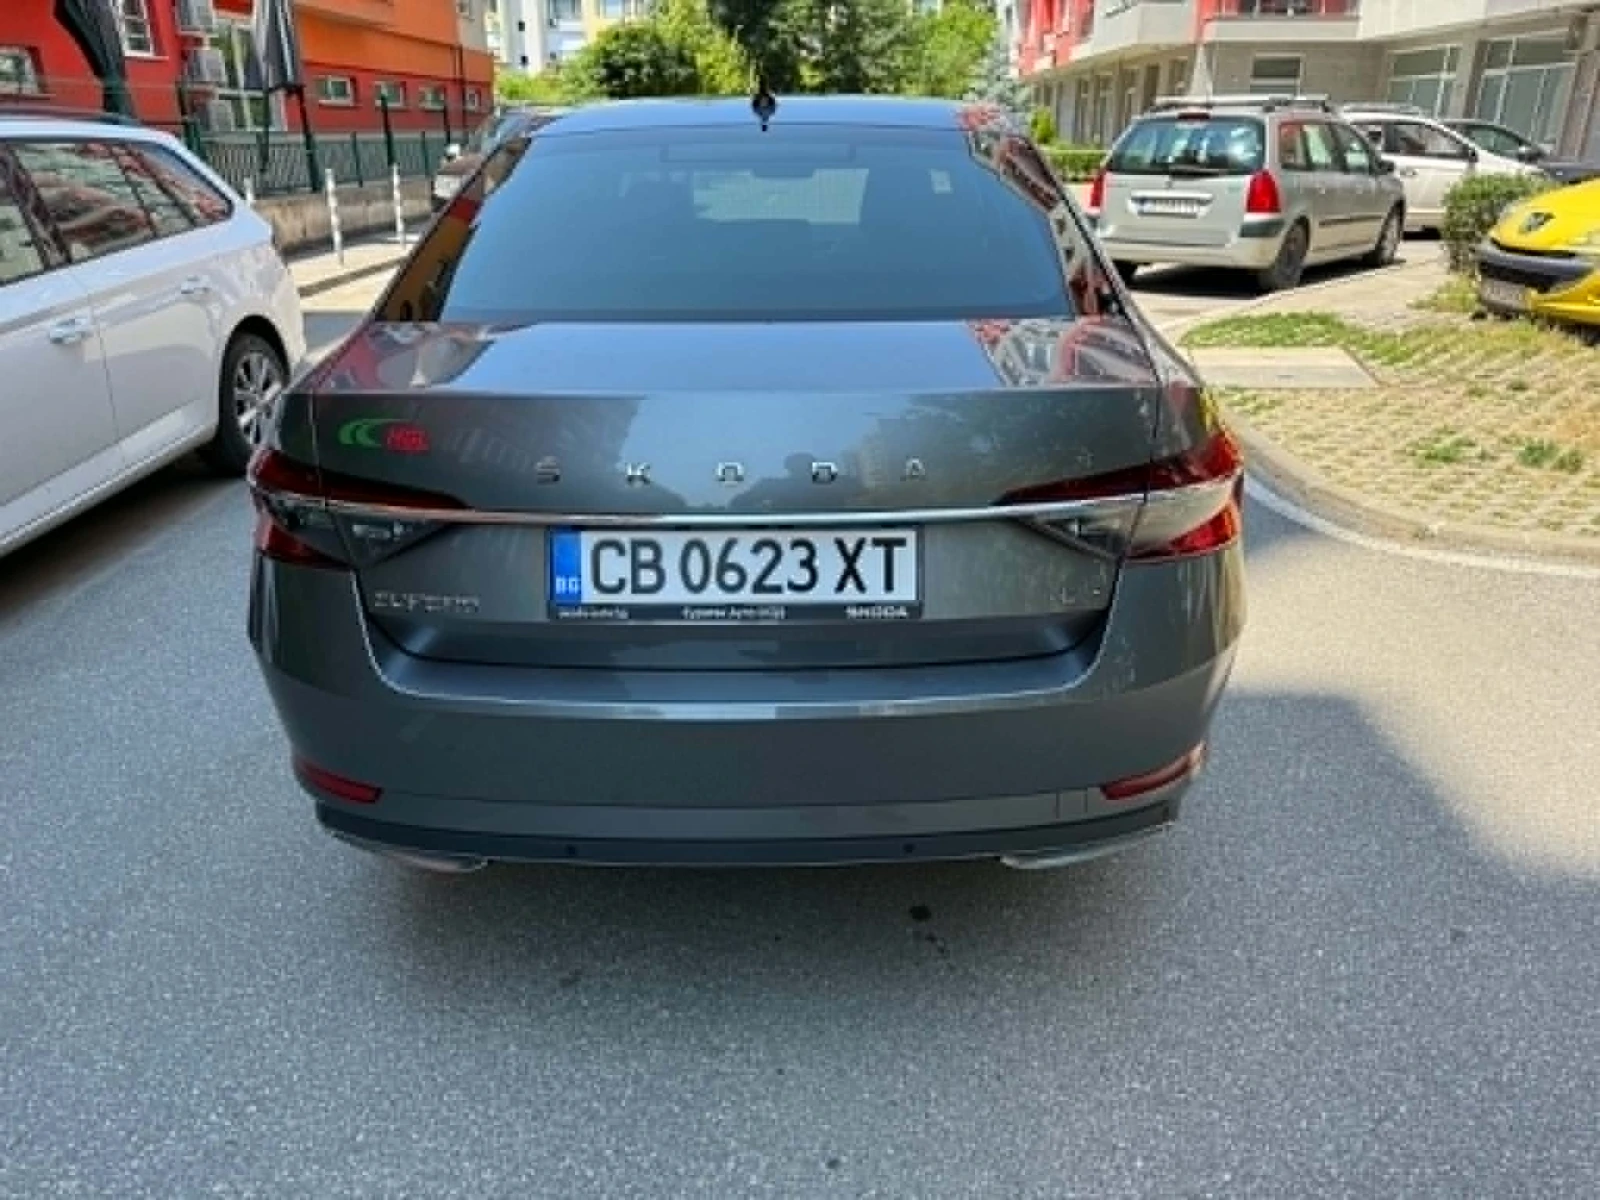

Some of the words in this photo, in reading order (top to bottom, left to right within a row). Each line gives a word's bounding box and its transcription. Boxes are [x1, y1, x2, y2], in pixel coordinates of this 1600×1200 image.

[590, 538, 666, 595] CB
[679, 538, 819, 595] 0623
[833, 537, 907, 594] XT
